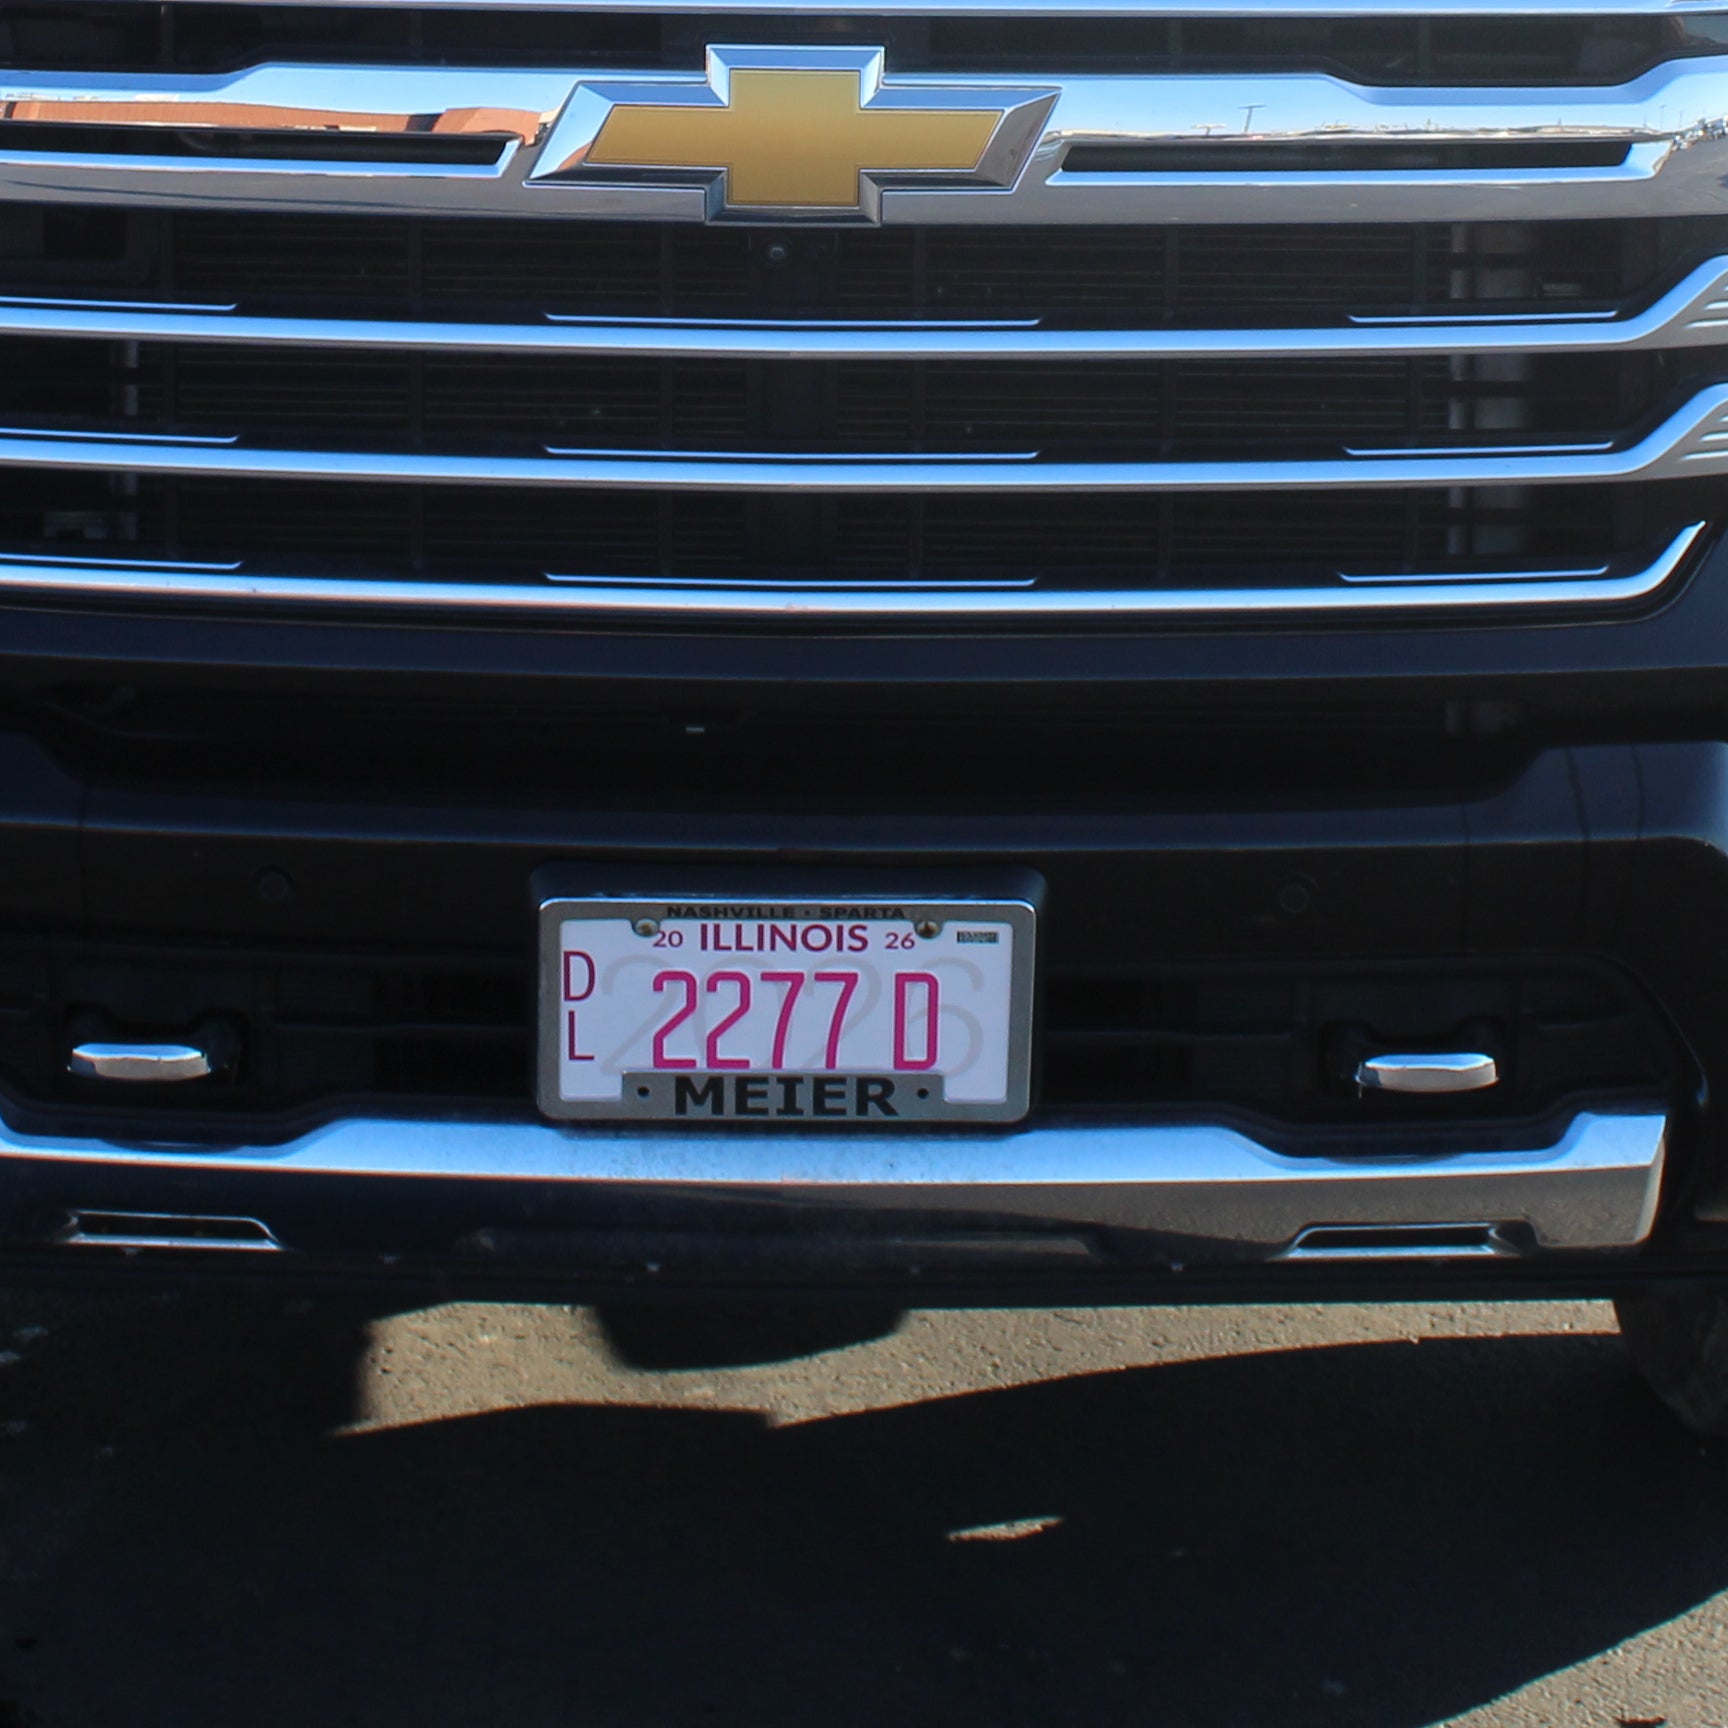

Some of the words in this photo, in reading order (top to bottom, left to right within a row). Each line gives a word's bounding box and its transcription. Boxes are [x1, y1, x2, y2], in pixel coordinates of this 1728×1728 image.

[667, 905, 794, 920] NASHVILLE
[819, 906, 906, 920] SPARTA
[652, 930, 683, 948] 20
[700, 923, 869, 953] ILLINOIS
[885, 932, 915, 950] 26
[652, 970, 859, 1069] 2277
[893, 972, 940, 1070] D
[674, 1076, 899, 1117] MEIER
